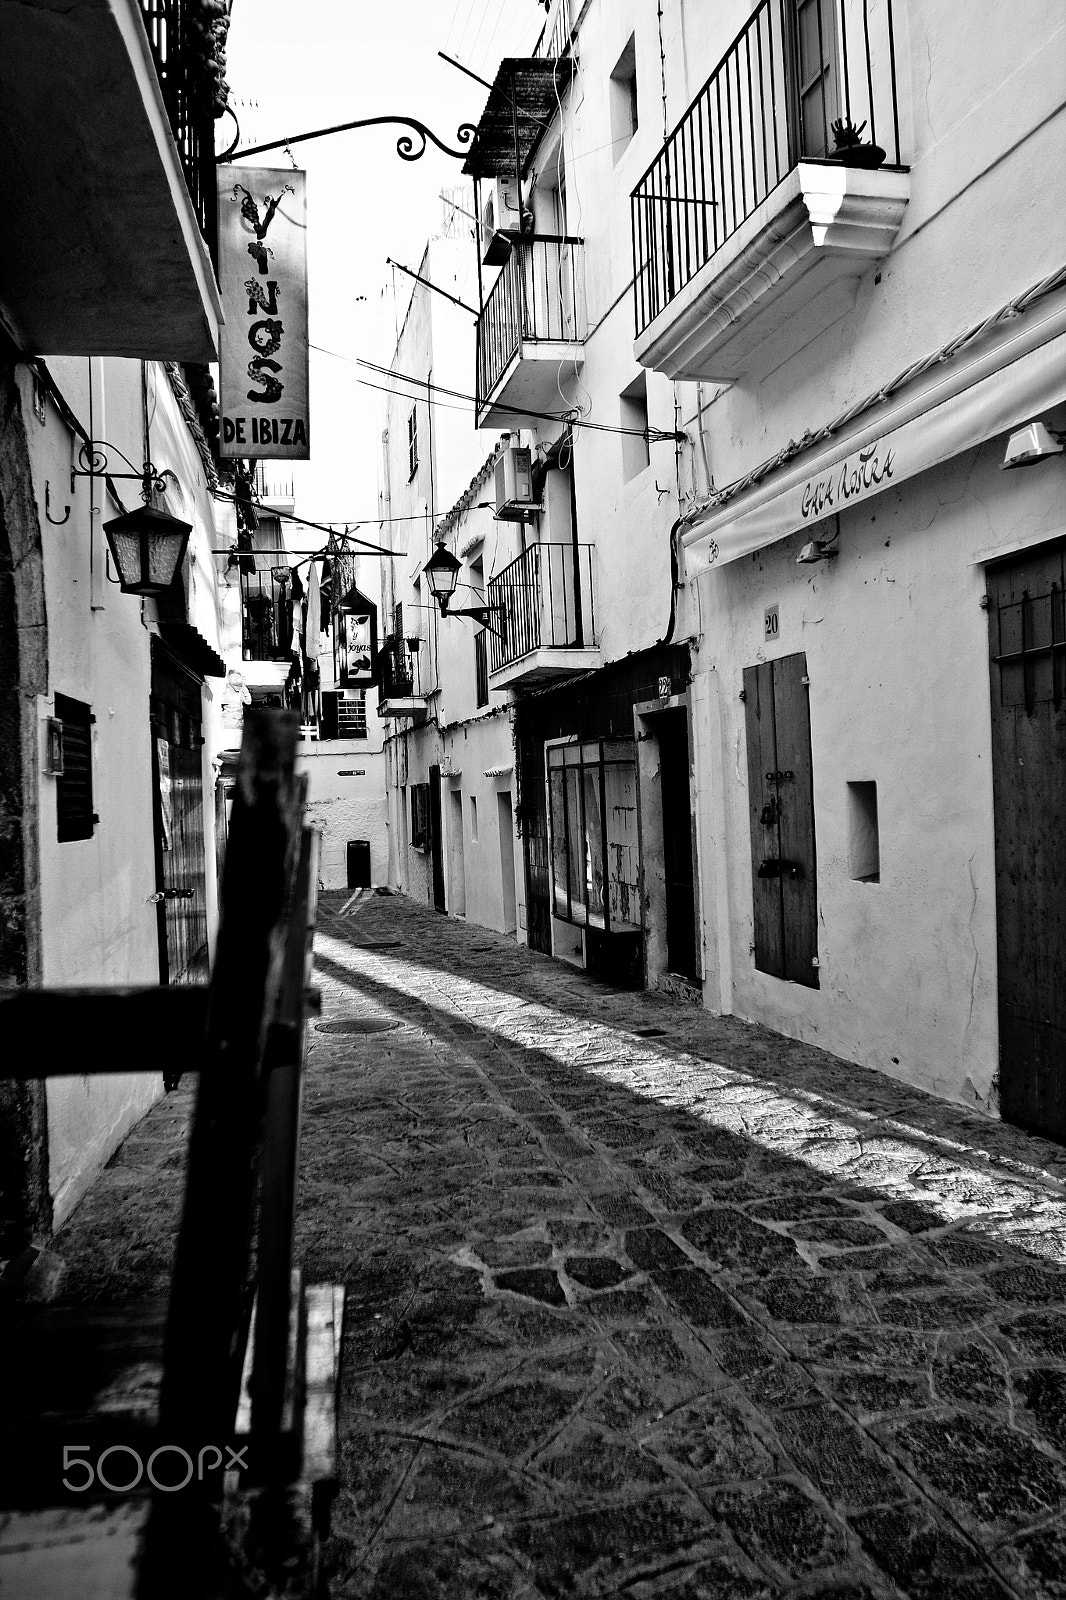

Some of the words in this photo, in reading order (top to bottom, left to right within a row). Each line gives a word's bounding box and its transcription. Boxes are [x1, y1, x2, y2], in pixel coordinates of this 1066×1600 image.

[231, 184, 295, 404] VINOS
[223, 417, 246, 443] DE
[252, 417, 307, 446] IBIZA
[765, 613, 778, 634] 20
[347, 642, 371, 653] joyas
